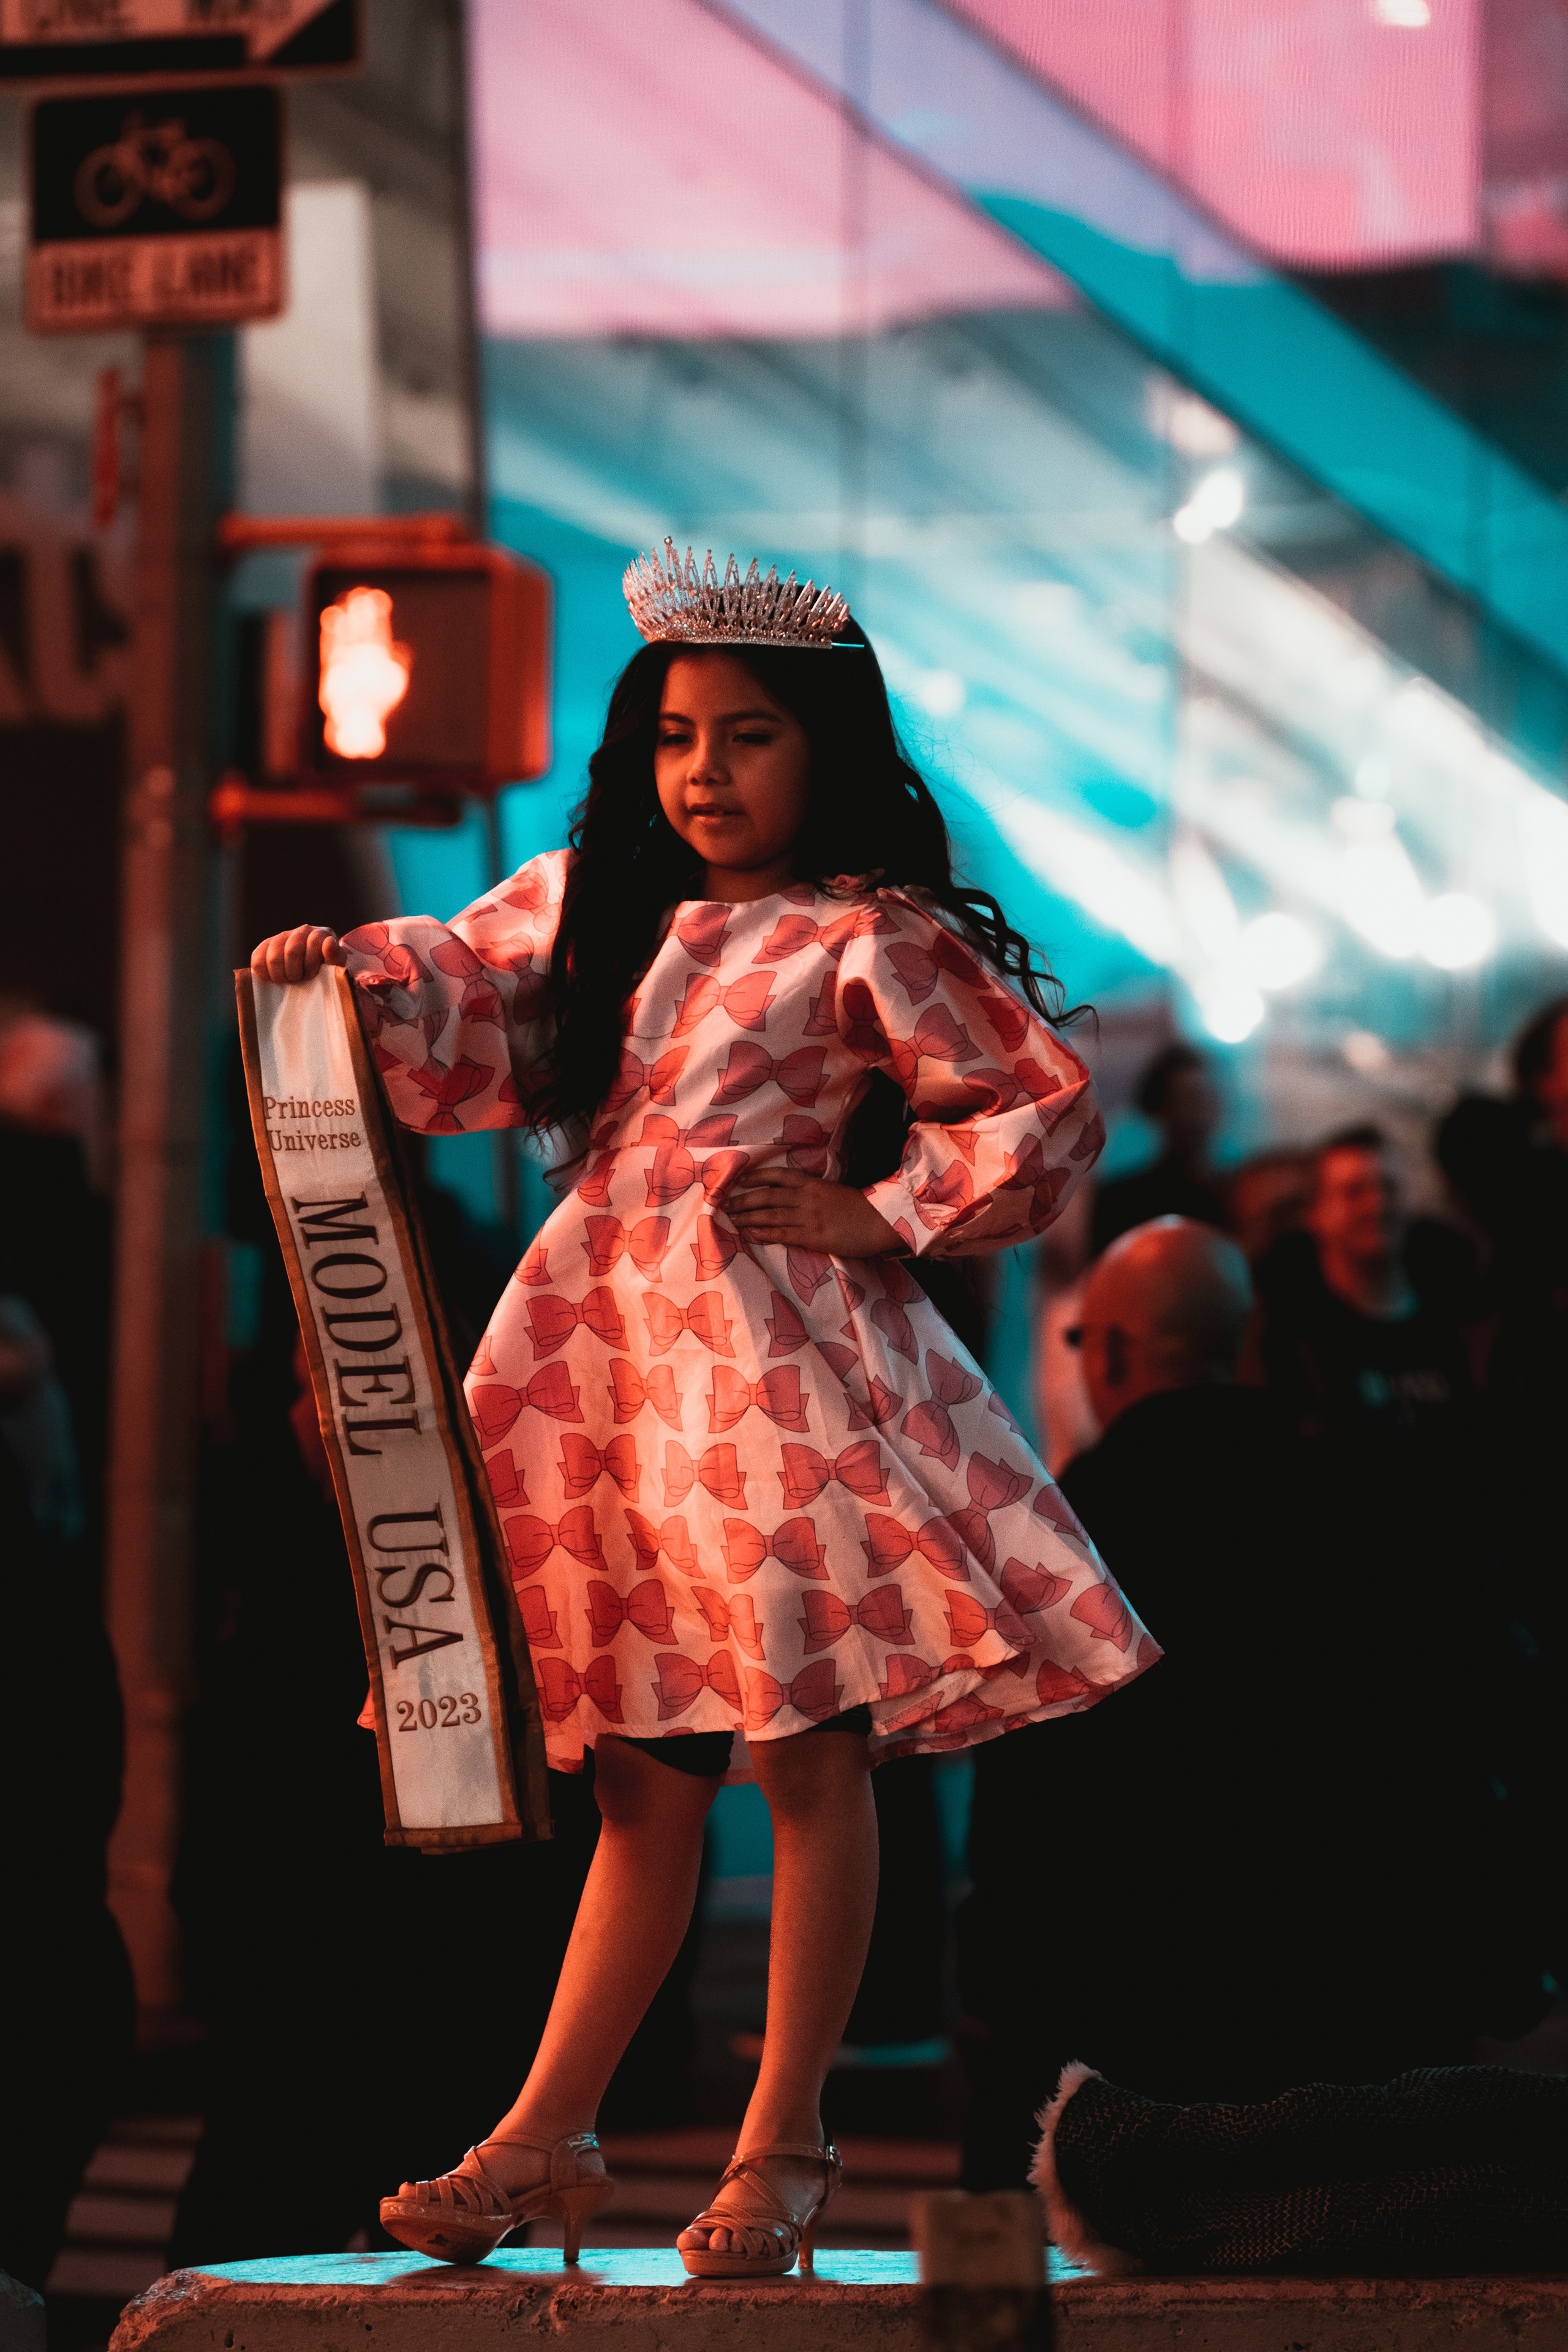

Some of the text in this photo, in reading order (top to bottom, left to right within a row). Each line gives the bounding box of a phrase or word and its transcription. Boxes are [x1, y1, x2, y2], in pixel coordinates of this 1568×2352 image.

[263, 1096, 356, 1120] Princess
[266, 1129, 361, 1152] Universe
[290, 1191, 464, 1670] MODEL USA
[396, 1692, 482, 1732] 2023
